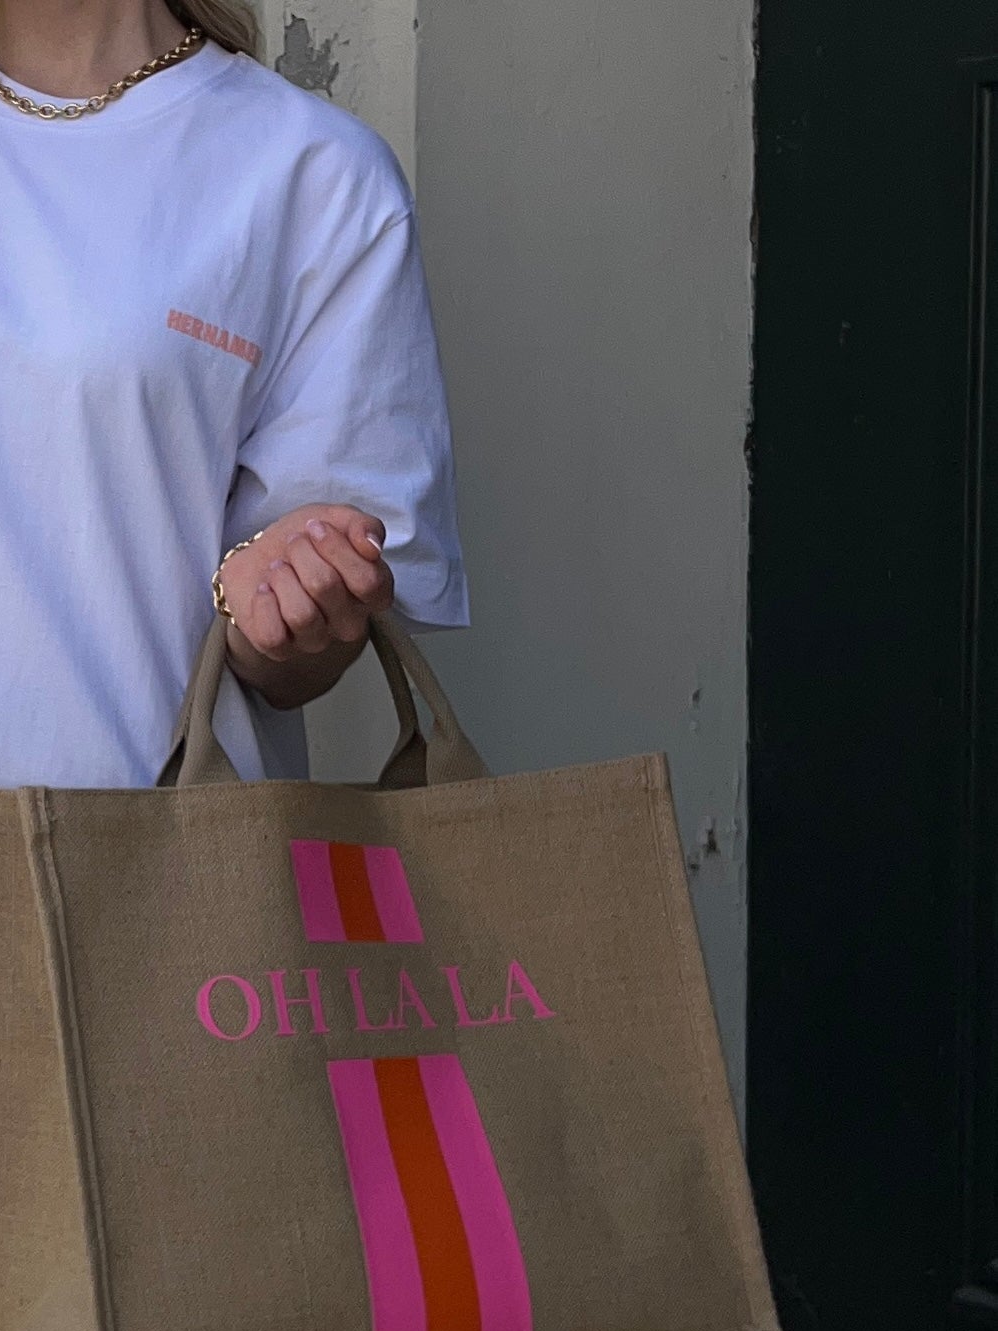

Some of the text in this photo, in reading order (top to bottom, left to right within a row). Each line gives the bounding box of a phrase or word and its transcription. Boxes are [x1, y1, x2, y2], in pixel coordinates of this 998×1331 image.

[196, 959, 557, 1041] OH LA LA
